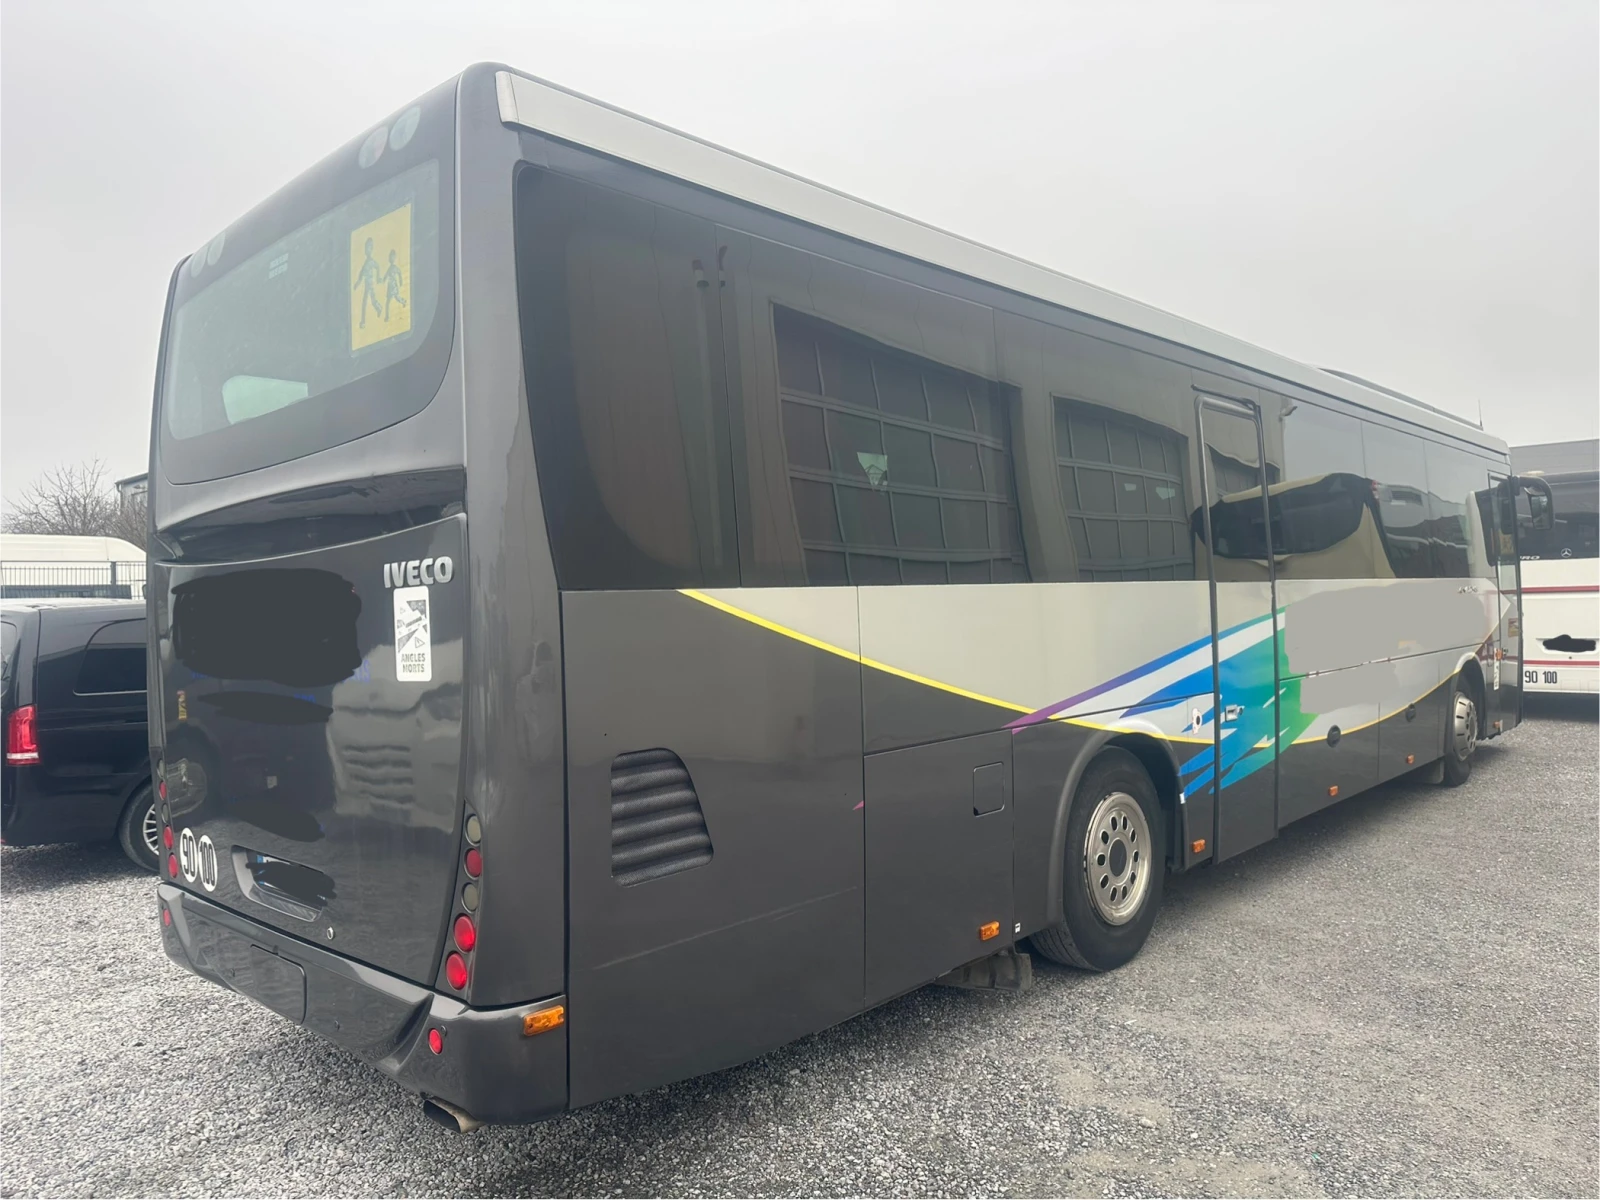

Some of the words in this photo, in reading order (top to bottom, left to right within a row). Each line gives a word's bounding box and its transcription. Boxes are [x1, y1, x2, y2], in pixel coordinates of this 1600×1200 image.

[383, 556, 453, 588] IVECO
[401, 653, 426, 663] ANGLES
[402, 663, 425, 673] MORTS
[1524, 670, 1538, 684] 90
[1542, 670, 1558, 684] 100
[182, 833, 196, 877] 90
[199, 841, 216, 887] 100
